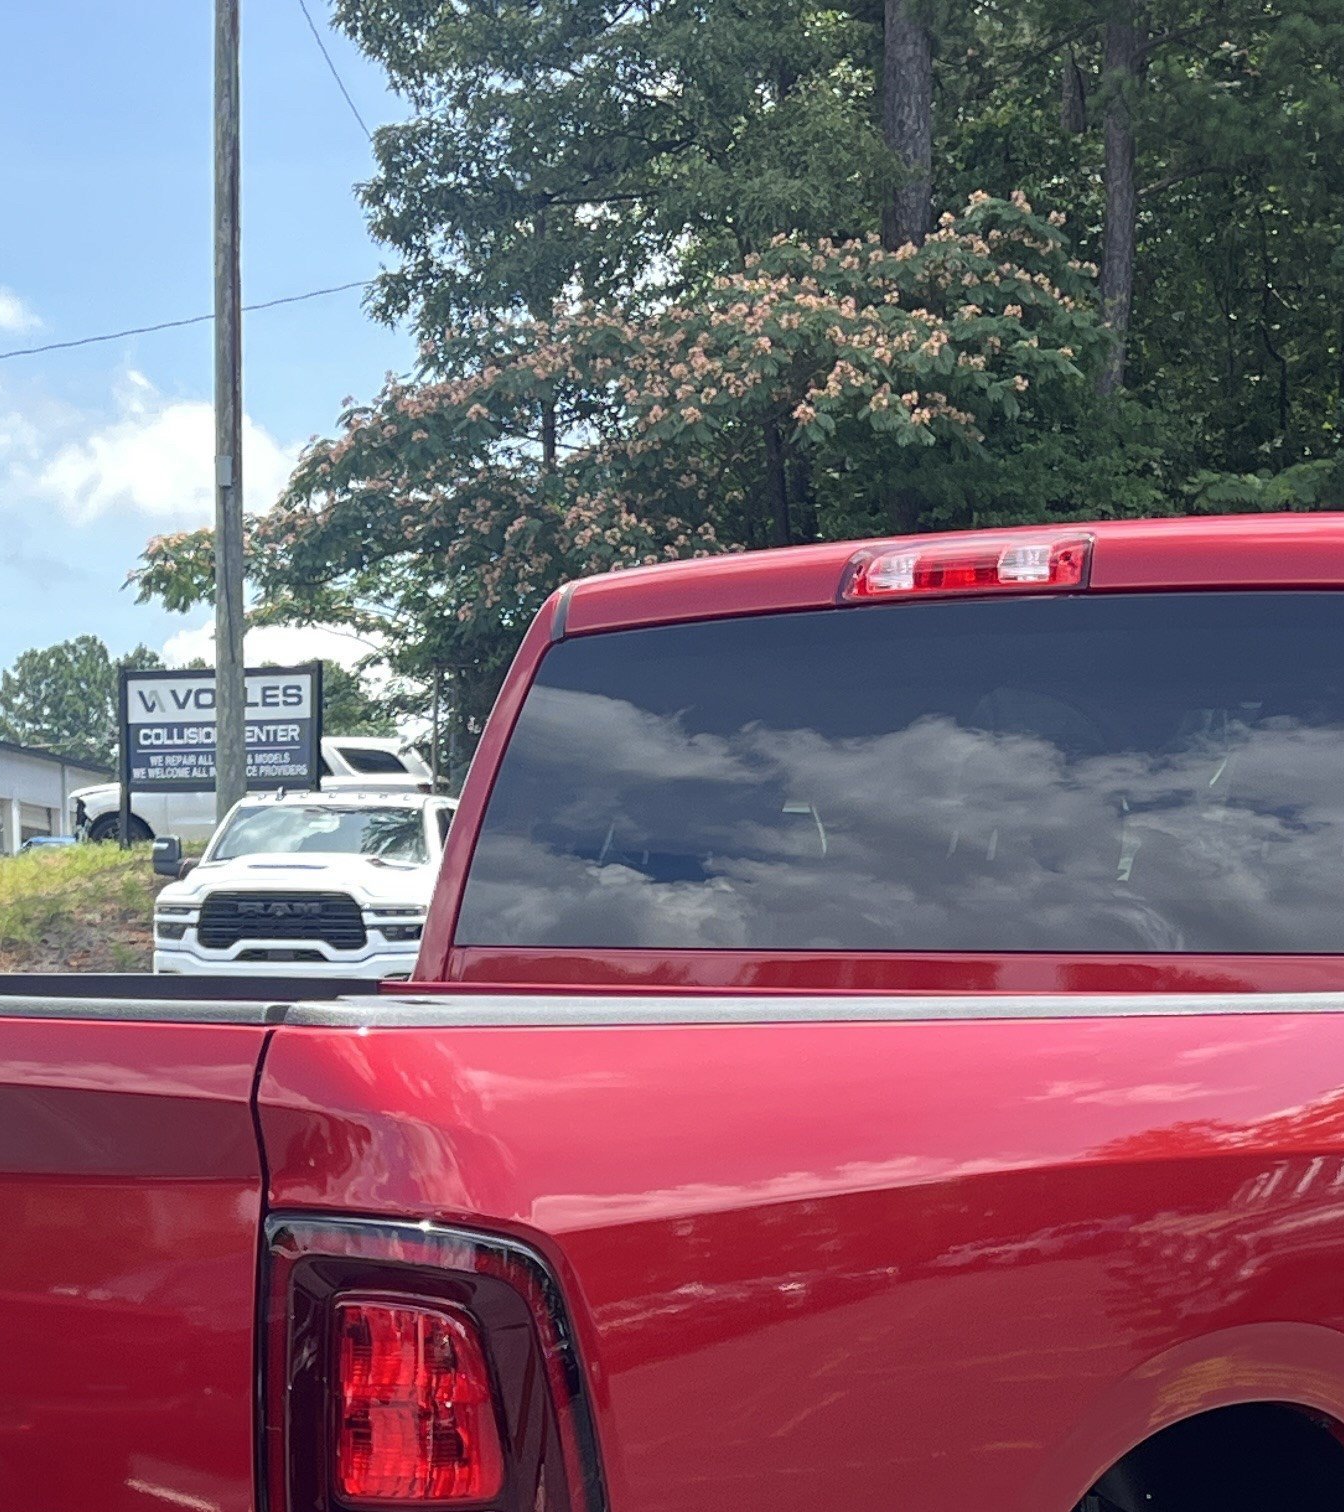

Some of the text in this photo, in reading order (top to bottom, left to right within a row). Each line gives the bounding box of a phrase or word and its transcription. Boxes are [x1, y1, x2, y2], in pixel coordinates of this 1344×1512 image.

[170, 685, 304, 710] VOLES
[139, 724, 301, 746] COLLISIO ENTER
[149, 755, 163, 766] WE
[197, 754, 214, 766] ALL
[237, 901, 320, 917] RAM
